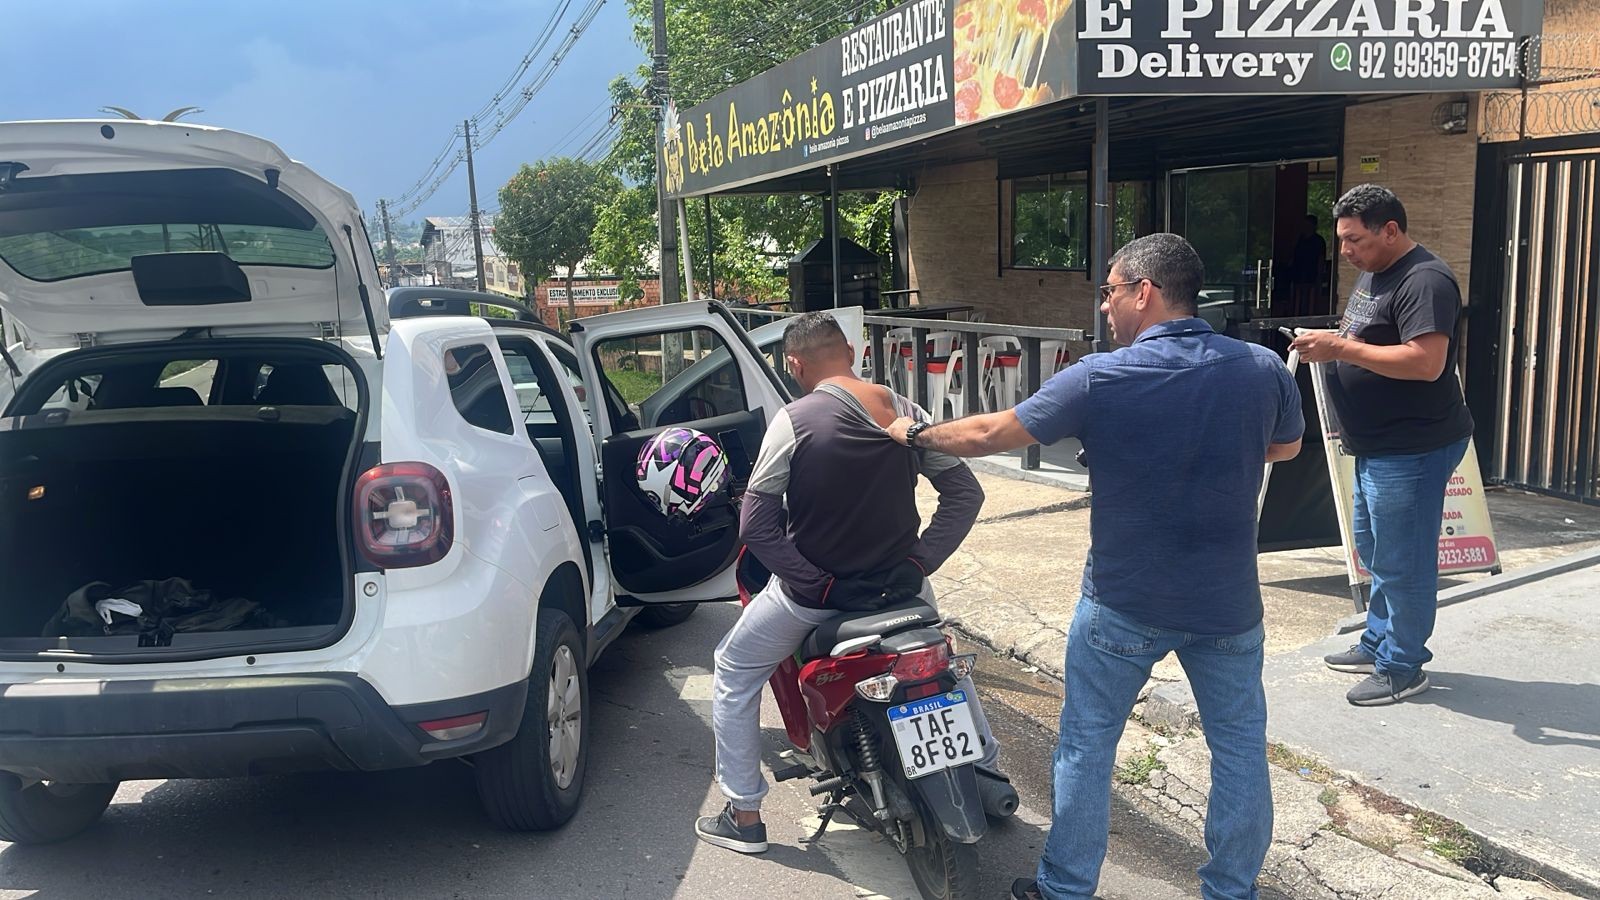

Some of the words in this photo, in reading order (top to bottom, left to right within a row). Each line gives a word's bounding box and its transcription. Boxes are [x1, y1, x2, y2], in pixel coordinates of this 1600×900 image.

[1078, 0, 1132, 39] E
[1160, 0, 1514, 39] PIZZARIA
[841, 0, 946, 77] RESTAURANTE
[1097, 43, 1314, 86] Delivery
[1358, 41, 1386, 79] 92
[1393, 41, 1516, 79] 99359-8754
[842, 87, 854, 130] E
[857, 54, 948, 125] PIZZARIA
[686, 112, 724, 176] Bela
[727, 75, 836, 164] Amazônia
[871, 112, 927, 139] @belaamazoniapizzas
[549, 288, 596, 297] ESTACIAMENTO
[597, 288, 619, 296] EXCLUSI
[1448, 476, 1465, 485] RITO
[1443, 511, 1463, 520] RADA
[1438, 546, 1488, 565] 9232-5881
[886, 614, 923, 627] HONDA
[912, 701, 943, 715] BRASIL
[910, 708, 955, 741] TAF
[911, 732, 974, 769] 8F82
[906, 765, 918, 776] BR
